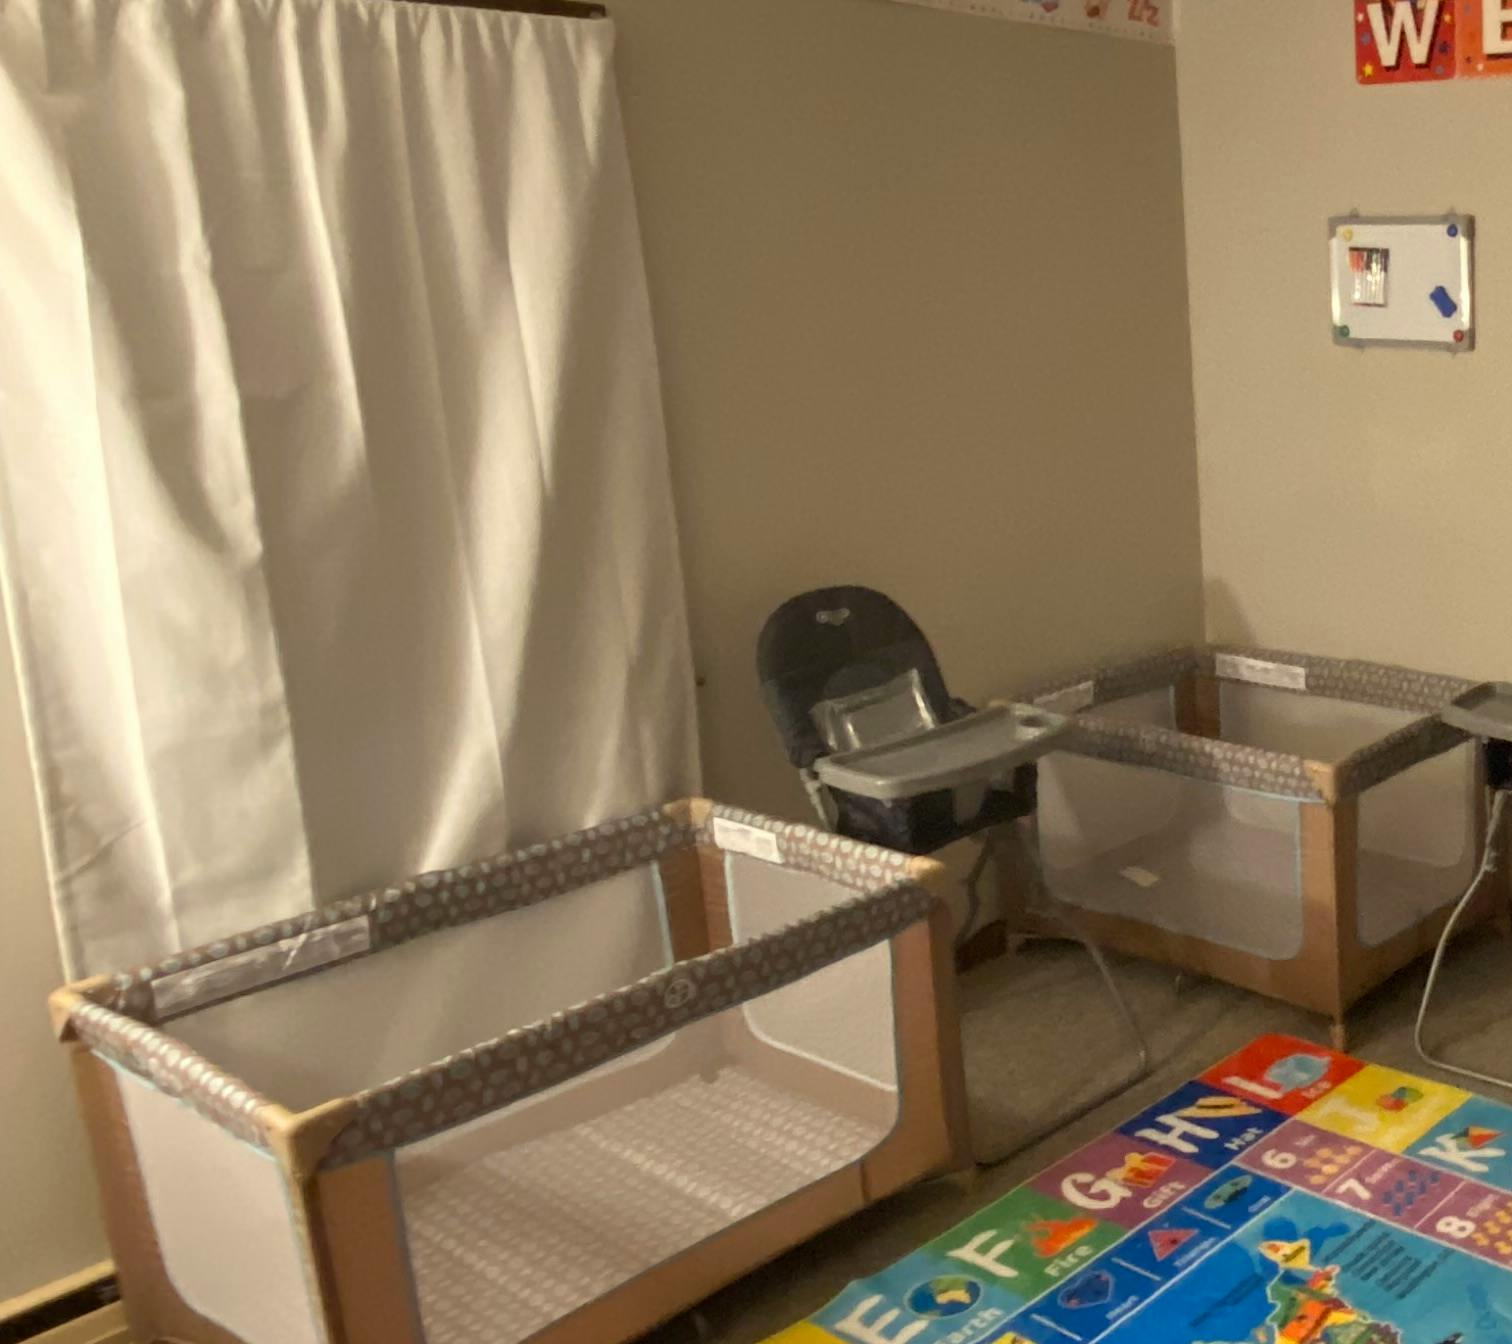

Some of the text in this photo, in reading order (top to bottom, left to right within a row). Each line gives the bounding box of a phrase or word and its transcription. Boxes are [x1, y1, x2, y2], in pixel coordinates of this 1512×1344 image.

[1134, 1113, 1220, 1154] H
[1223, 1126, 1264, 1152] Hat
[1261, 1147, 1297, 1169] 6
[1418, 1132, 1507, 1173] K
[1061, 1172, 1133, 1210] G
[1142, 1180, 1186, 1209] Gift
[1335, 1177, 1373, 1201] 7
[1435, 1215, 1477, 1240] 8
[947, 1229, 1020, 1279] F
[1043, 1244, 1095, 1279] Fire
